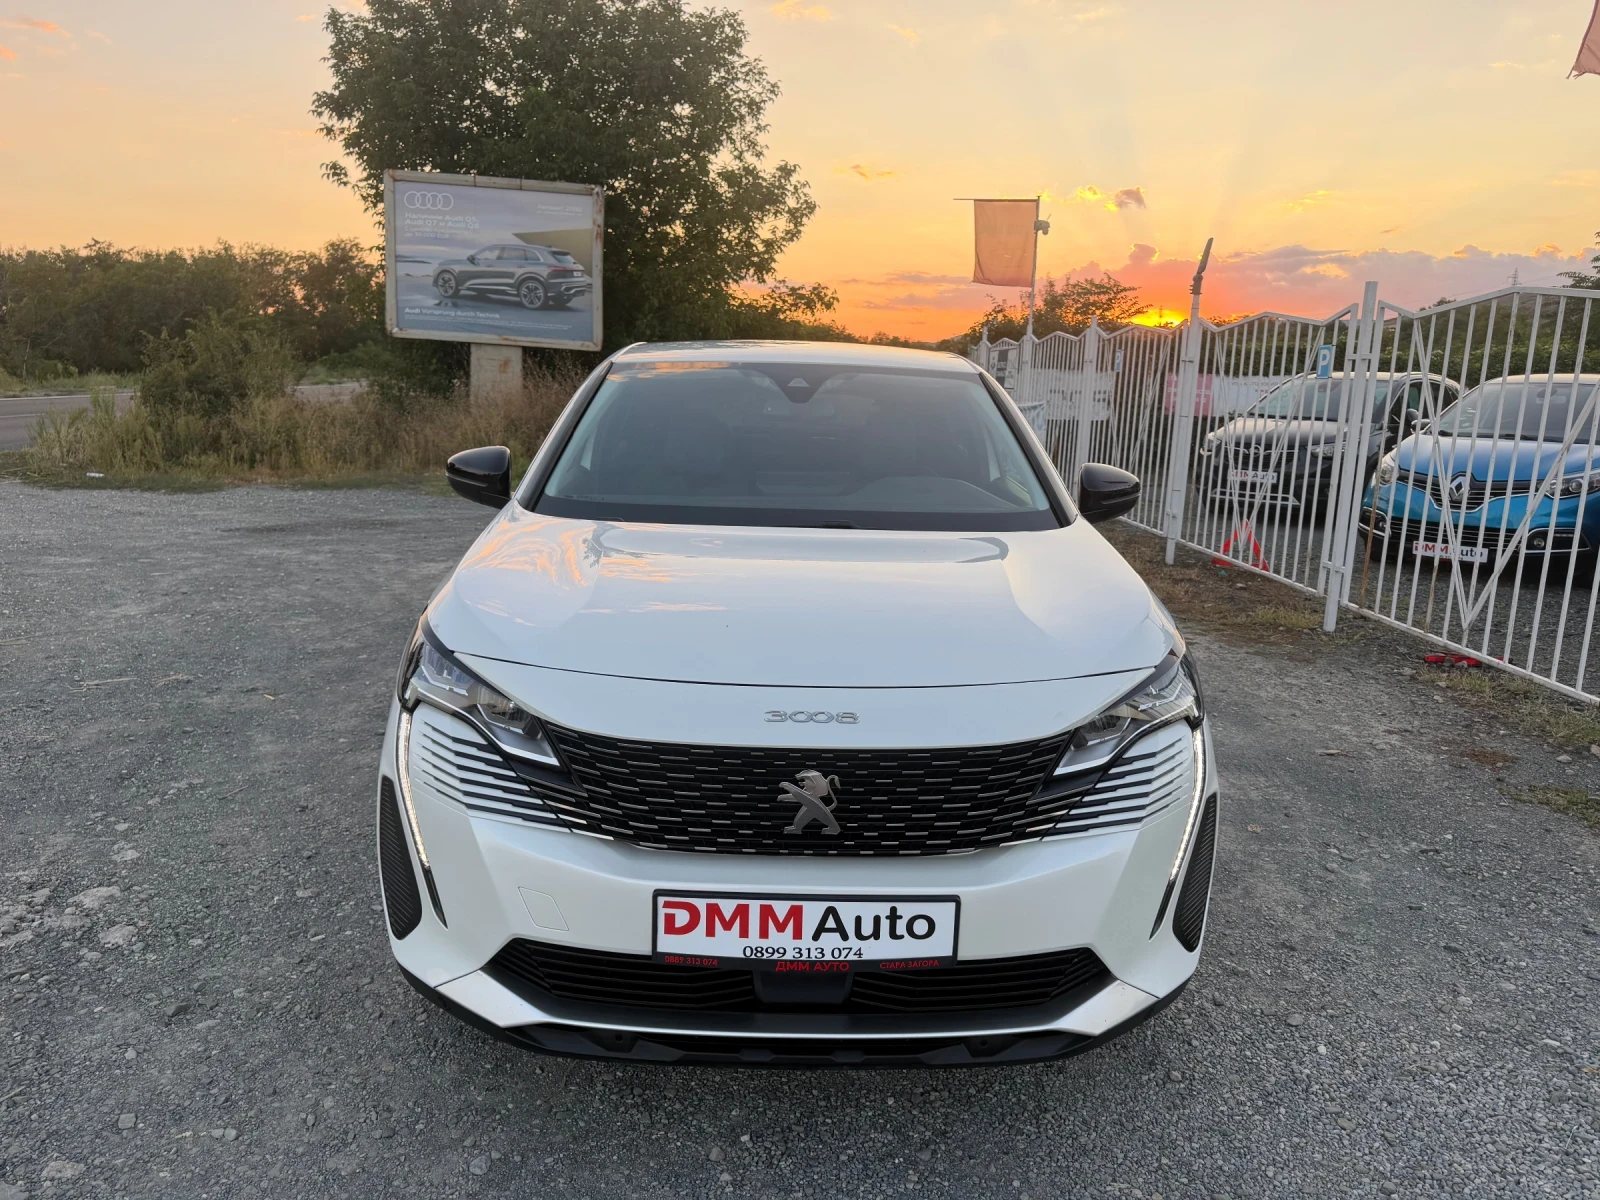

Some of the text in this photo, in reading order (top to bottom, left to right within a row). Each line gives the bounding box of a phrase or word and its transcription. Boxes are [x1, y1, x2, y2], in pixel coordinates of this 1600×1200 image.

[444, 214, 464, 222] Audi
[1317, 349, 1330, 375] P
[764, 710, 861, 724] 3008
[661, 899, 936, 942] DMM Auto
[742, 945, 864, 959] 0899 313 074
[664, 955, 718, 967] 0889 313 074
[775, 961, 850, 972] ДММ АУТО
[879, 959, 940, 970] СТАРА ЗАГОРА
